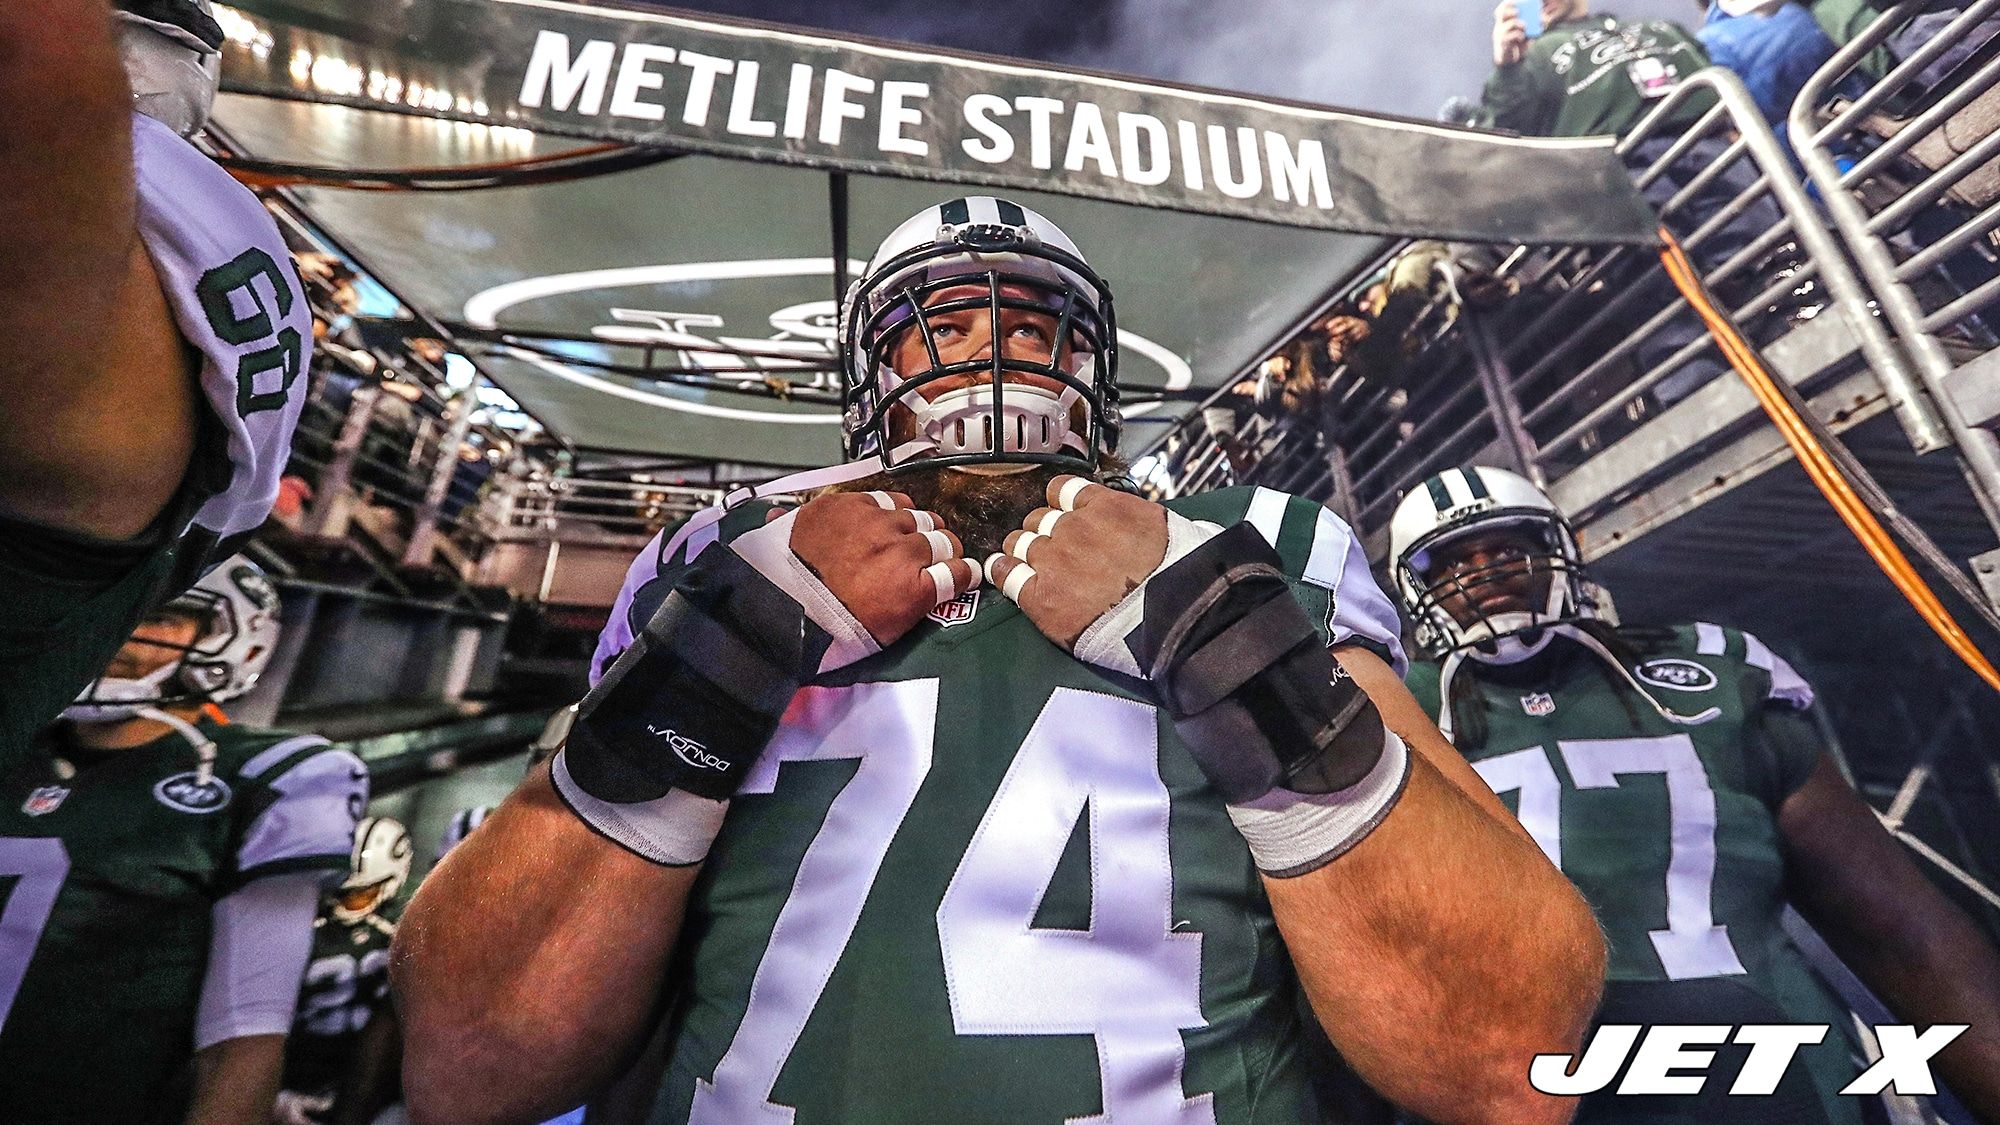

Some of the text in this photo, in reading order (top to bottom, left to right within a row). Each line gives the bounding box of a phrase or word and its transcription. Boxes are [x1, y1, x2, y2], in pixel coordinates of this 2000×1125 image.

[518, 29, 1336, 210] METLIFE STADIUM
[932, 601, 968, 619] NFL
[687, 677, 1217, 1125] 74
